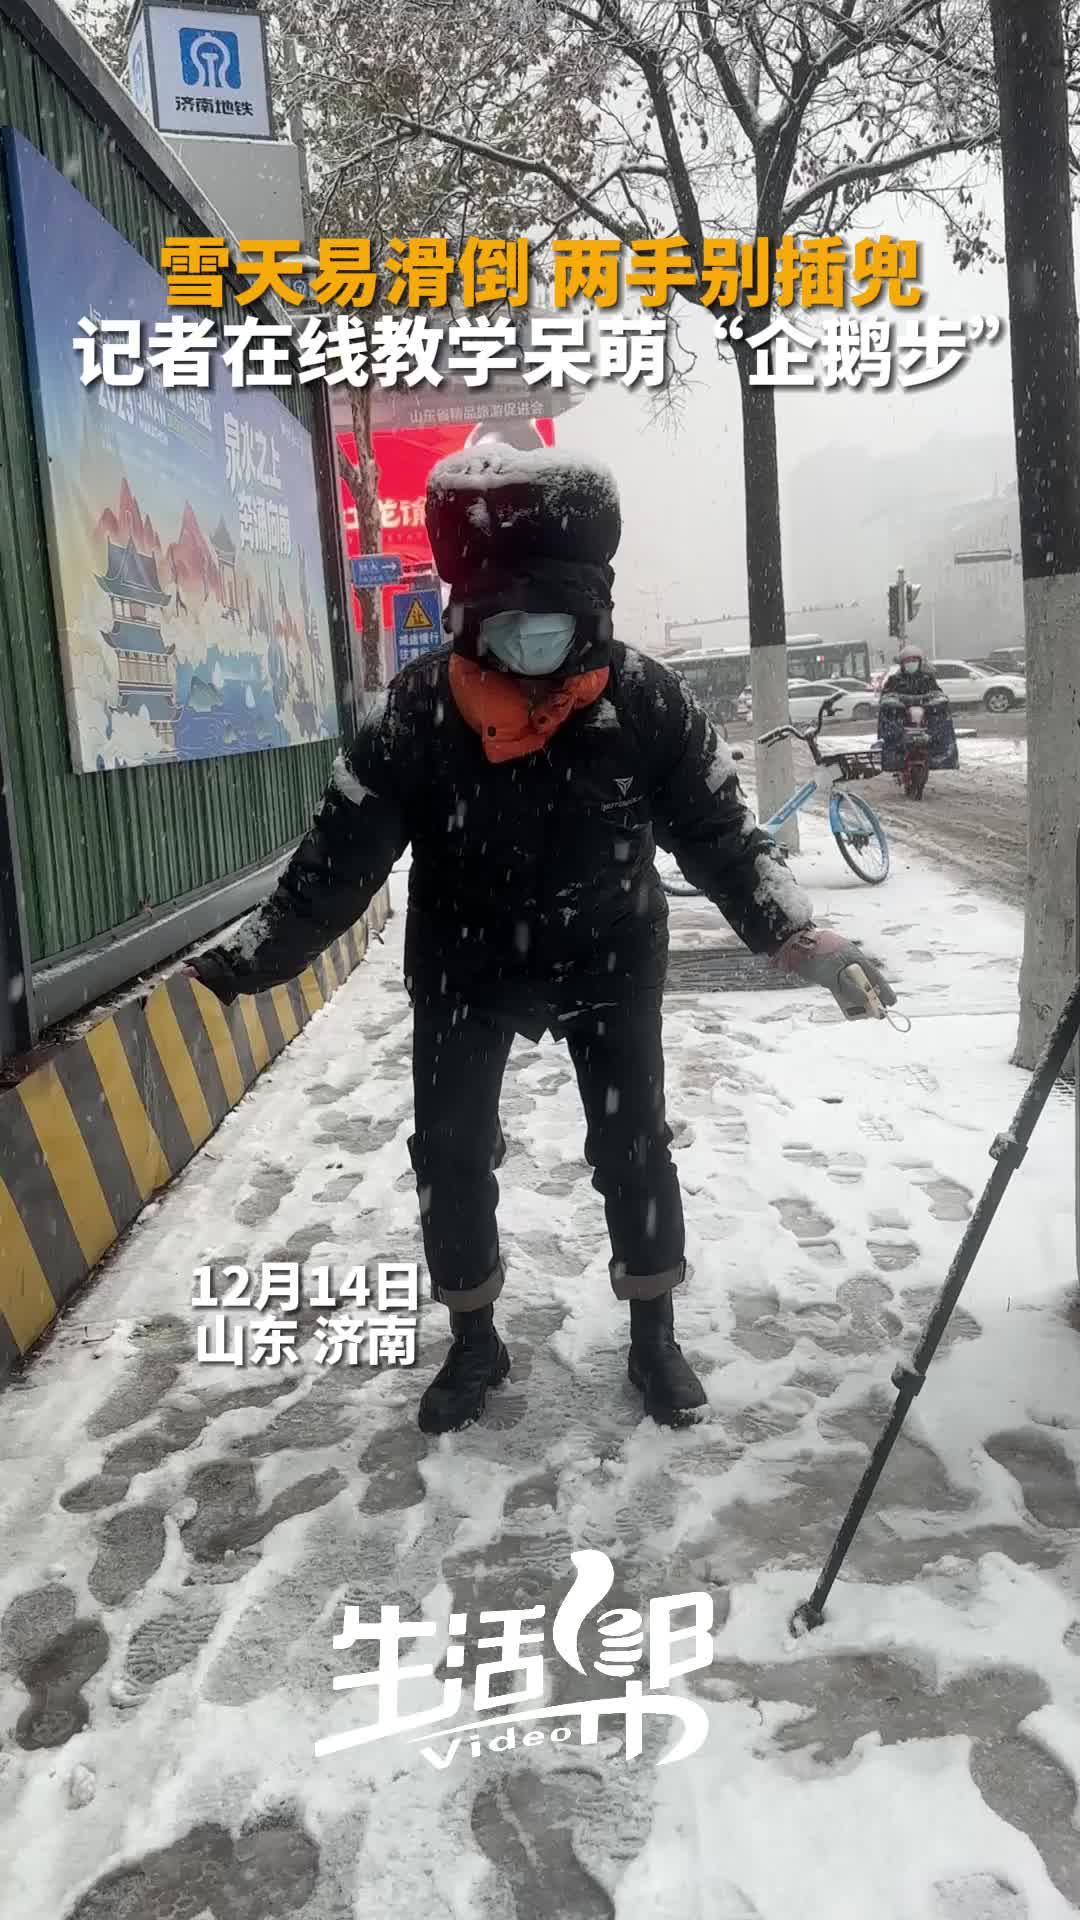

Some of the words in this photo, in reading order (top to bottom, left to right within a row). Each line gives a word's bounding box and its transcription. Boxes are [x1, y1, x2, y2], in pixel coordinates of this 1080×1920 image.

[175, 96, 253, 116] 济南地铁
[409, 400, 545, 423] 山东省精品旅游促进会
[223, 411, 282, 492] 泉水之上
